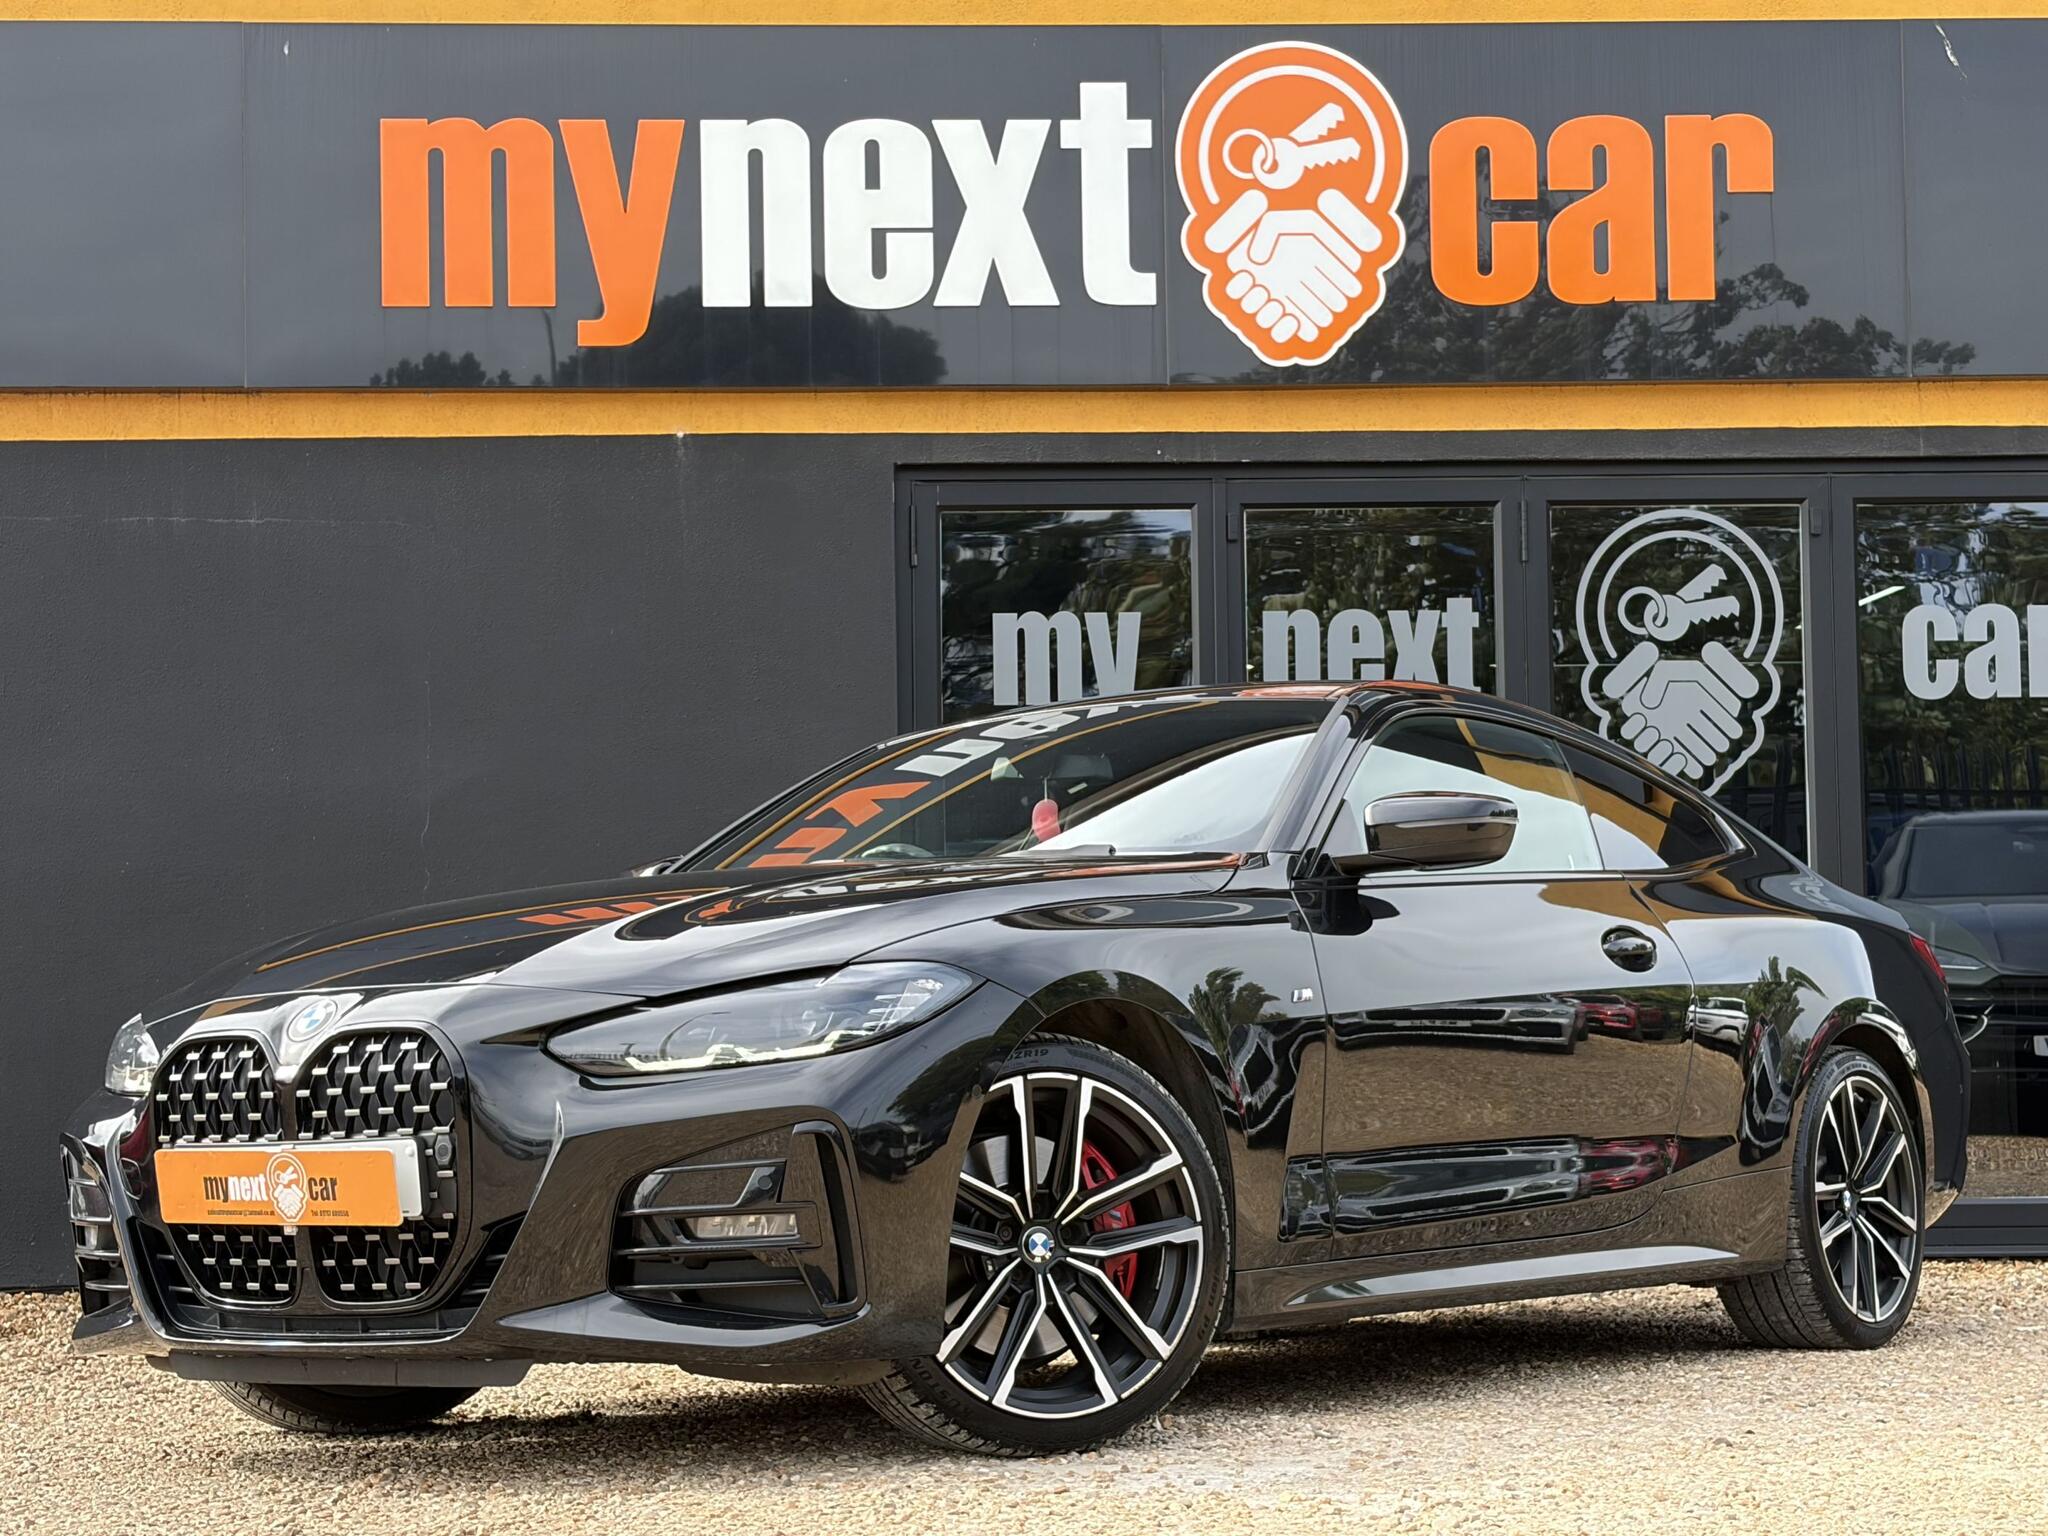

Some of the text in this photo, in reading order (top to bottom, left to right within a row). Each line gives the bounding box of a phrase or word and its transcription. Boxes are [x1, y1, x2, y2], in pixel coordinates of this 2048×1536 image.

[1429, 113, 1774, 306] car
[1262, 597, 1480, 692] next
[308, 1177, 338, 1202] car
